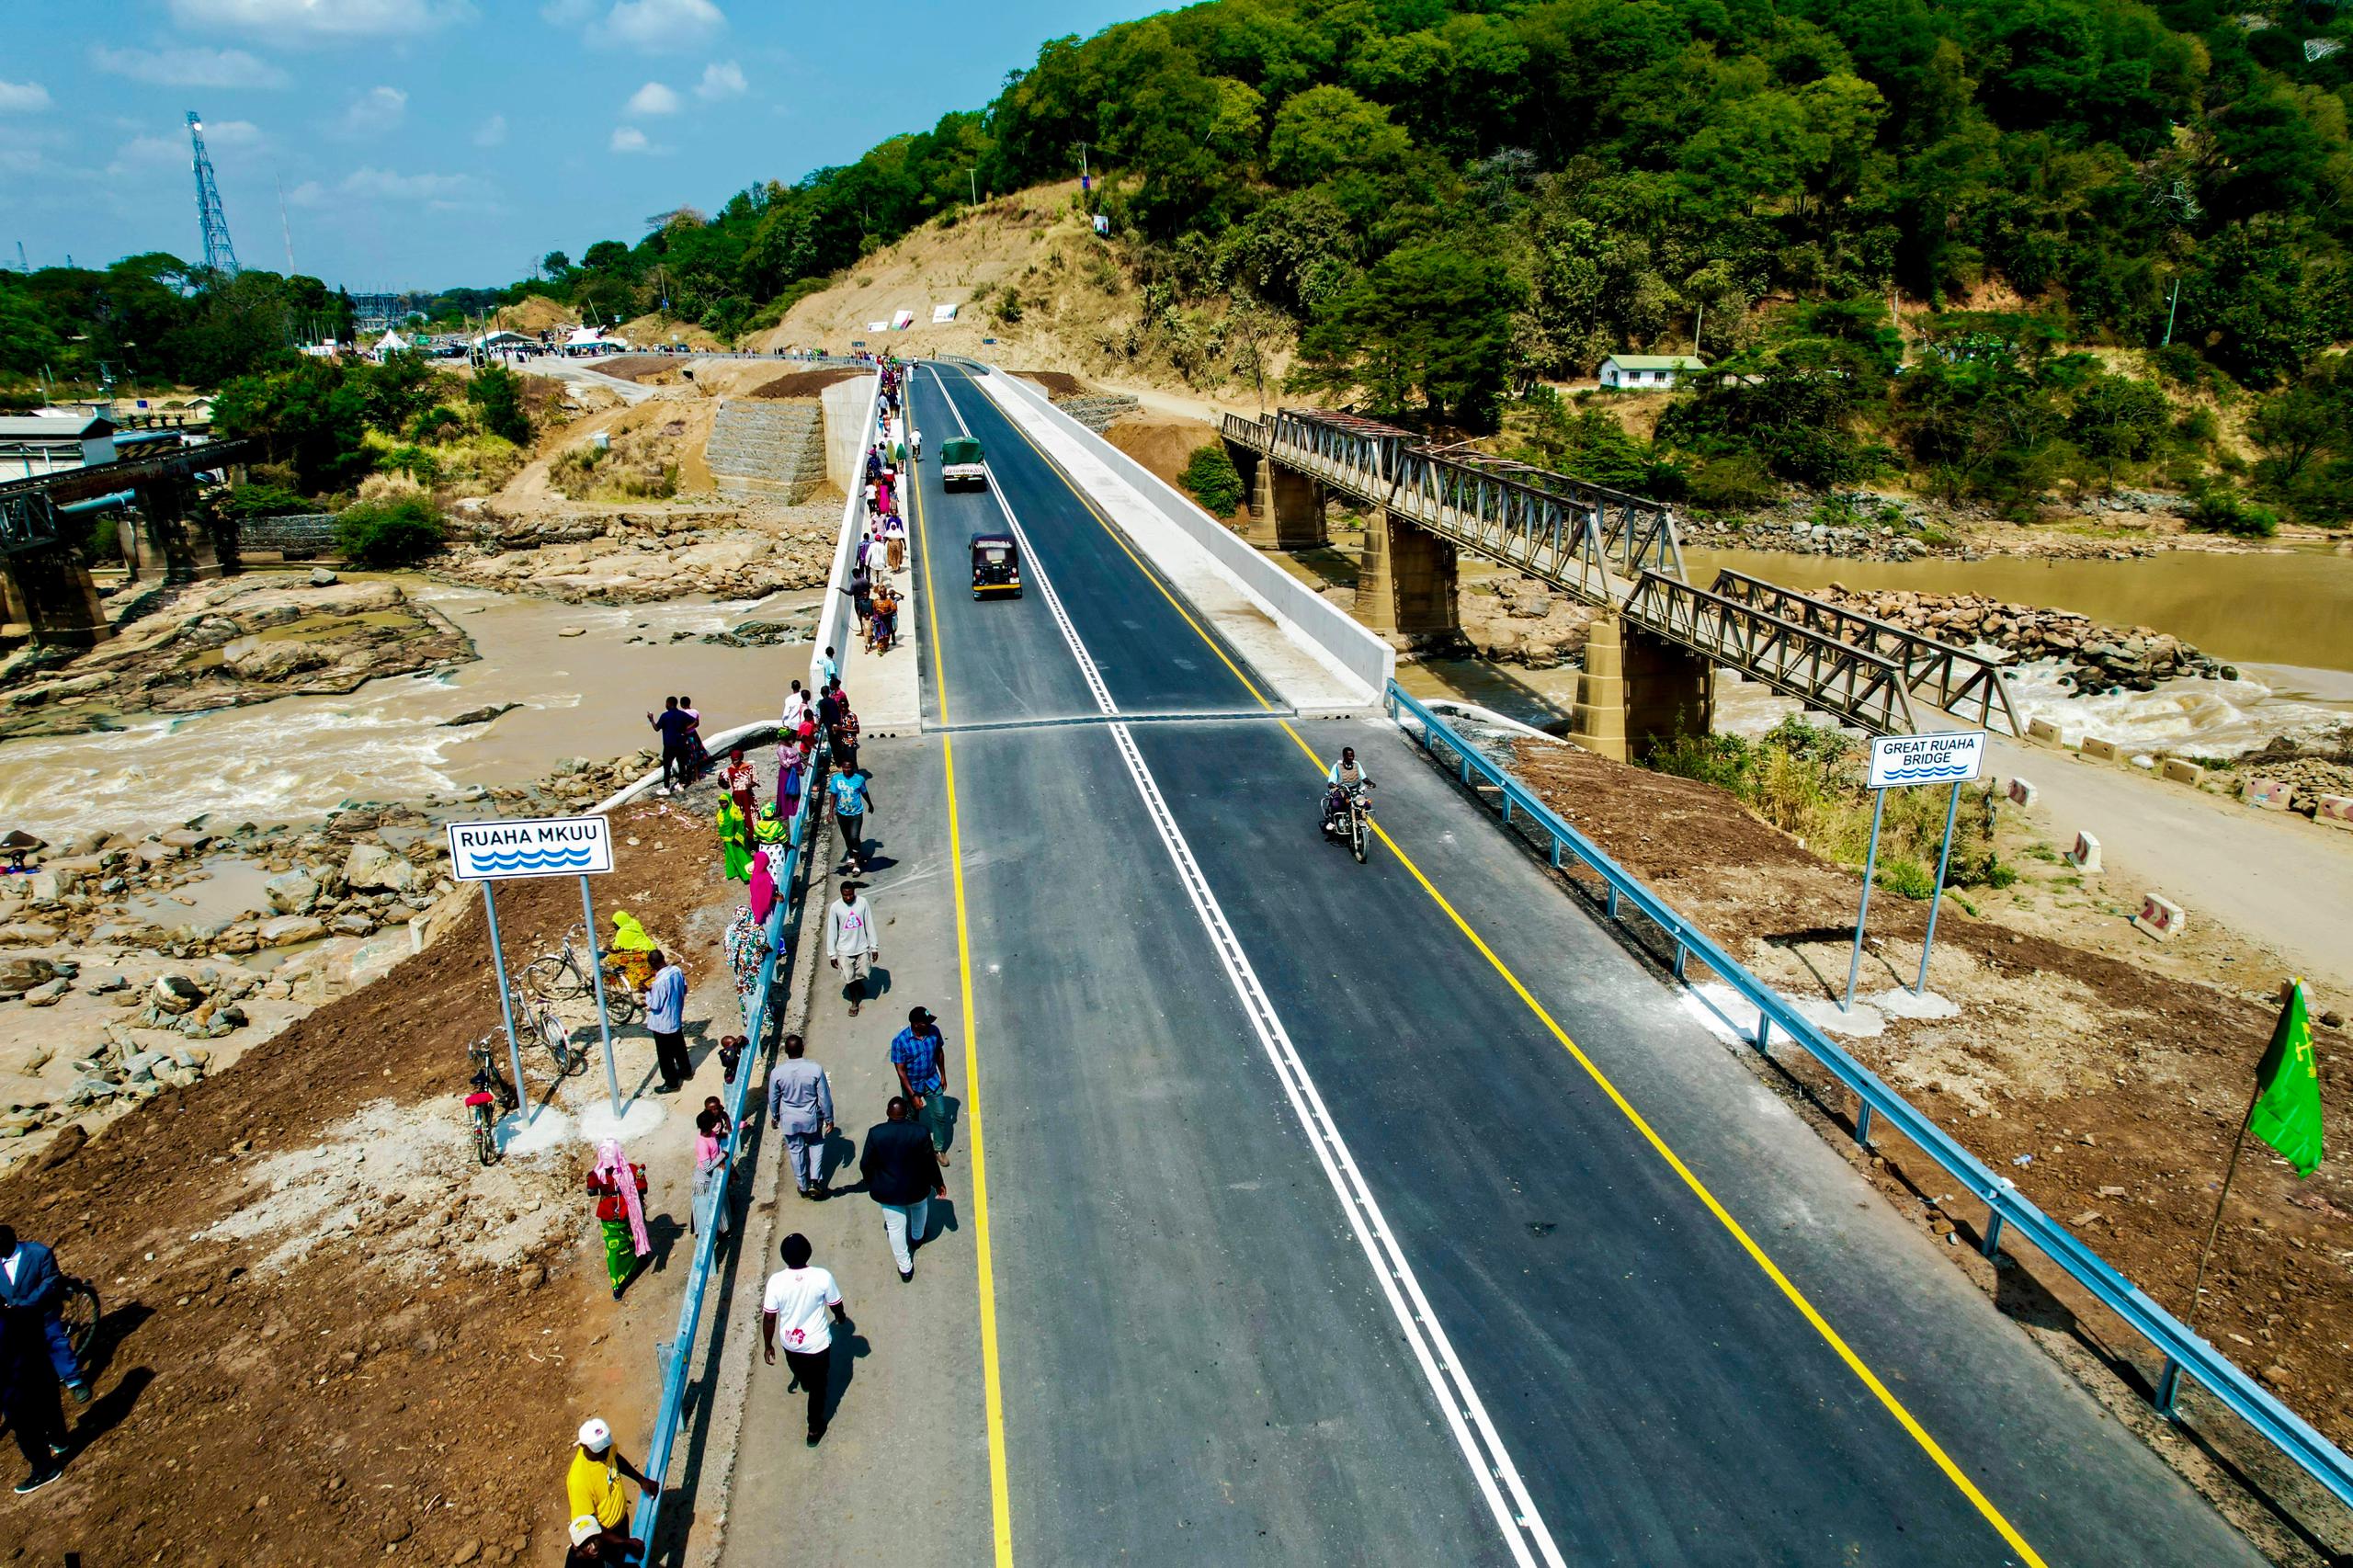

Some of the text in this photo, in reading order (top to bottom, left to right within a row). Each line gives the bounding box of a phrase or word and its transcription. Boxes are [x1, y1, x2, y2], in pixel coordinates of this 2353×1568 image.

[1883, 737, 1975, 755] GREAT RUAHA
[1903, 751, 1952, 767] BRIDGE
[460, 824, 597, 847] RUAHA MKUU
